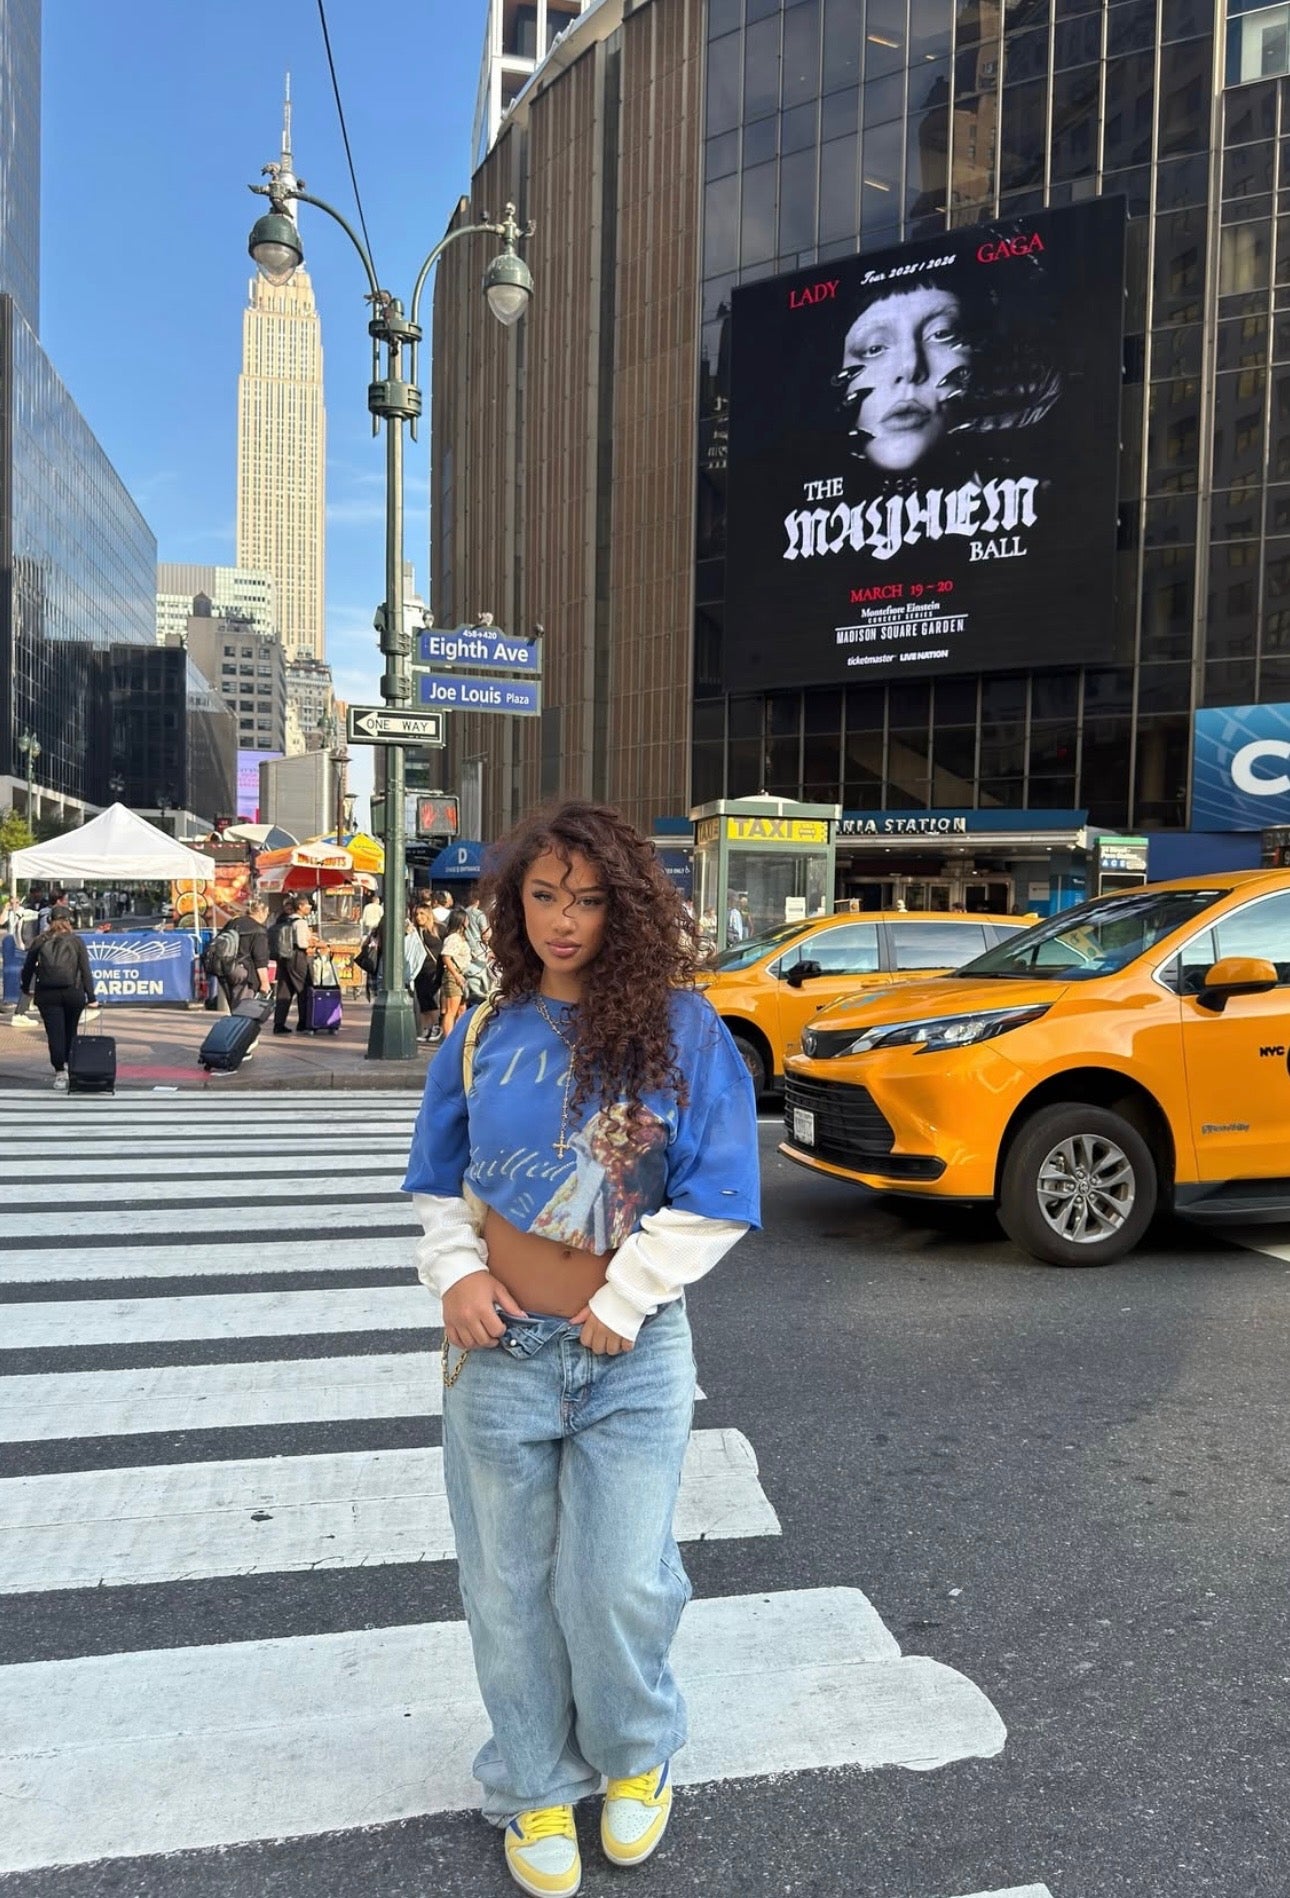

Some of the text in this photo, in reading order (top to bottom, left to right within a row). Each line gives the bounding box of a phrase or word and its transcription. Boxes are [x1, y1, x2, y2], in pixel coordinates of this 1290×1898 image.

[976, 232, 1045, 264] GAGA
[790, 279, 840, 309] LADY
[803, 477, 844, 501] THE
[783, 476, 1040, 560] MAYHEM
[969, 536, 1027, 562] BALL
[850, 584, 904, 603] MARCH
[910, 584, 924, 597] 19
[937, 580, 954, 593] 20
[861, 600, 940, 618] Montefiore Einstein
[836, 618, 965, 644] MADISON SQUARE GARDEN
[429, 636, 529, 663] Eighth Ave
[847, 654, 896, 666] ticketmaster
[429, 682, 530, 705] Joe Louis Plaza
[367, 718, 429, 733] ONE WAY
[733, 817, 793, 839] TAXI
[884, 817, 966, 833] STATION
[458, 847, 467, 864] D
[92, 969, 140, 979] OME TO
[94, 980, 164, 995] ARDEN
[1259, 1046, 1285, 1057] NYC
